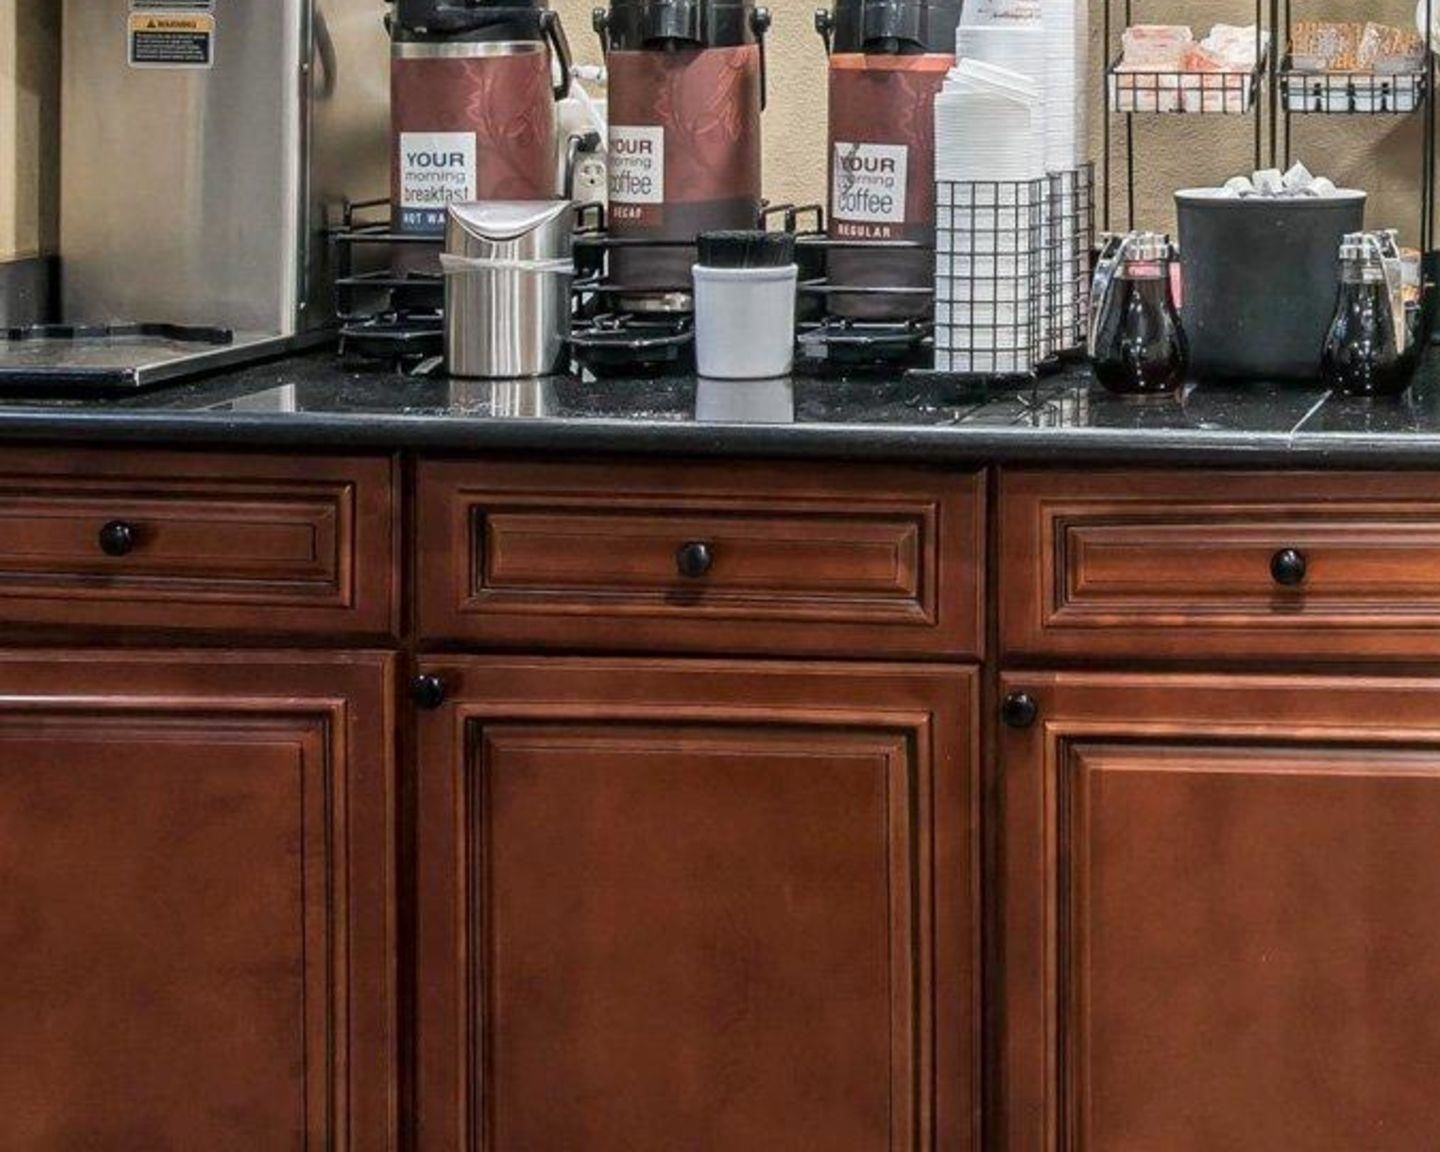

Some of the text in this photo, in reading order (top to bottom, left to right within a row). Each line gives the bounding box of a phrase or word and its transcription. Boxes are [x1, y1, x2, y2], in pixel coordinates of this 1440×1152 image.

[610, 138, 653, 155] OUR
[406, 152, 465, 167] YOUR
[840, 157, 896, 173] YOUR
[405, 171, 467, 185] morning
[404, 185, 469, 202] breakfast
[837, 223, 892, 238] REGULAR
